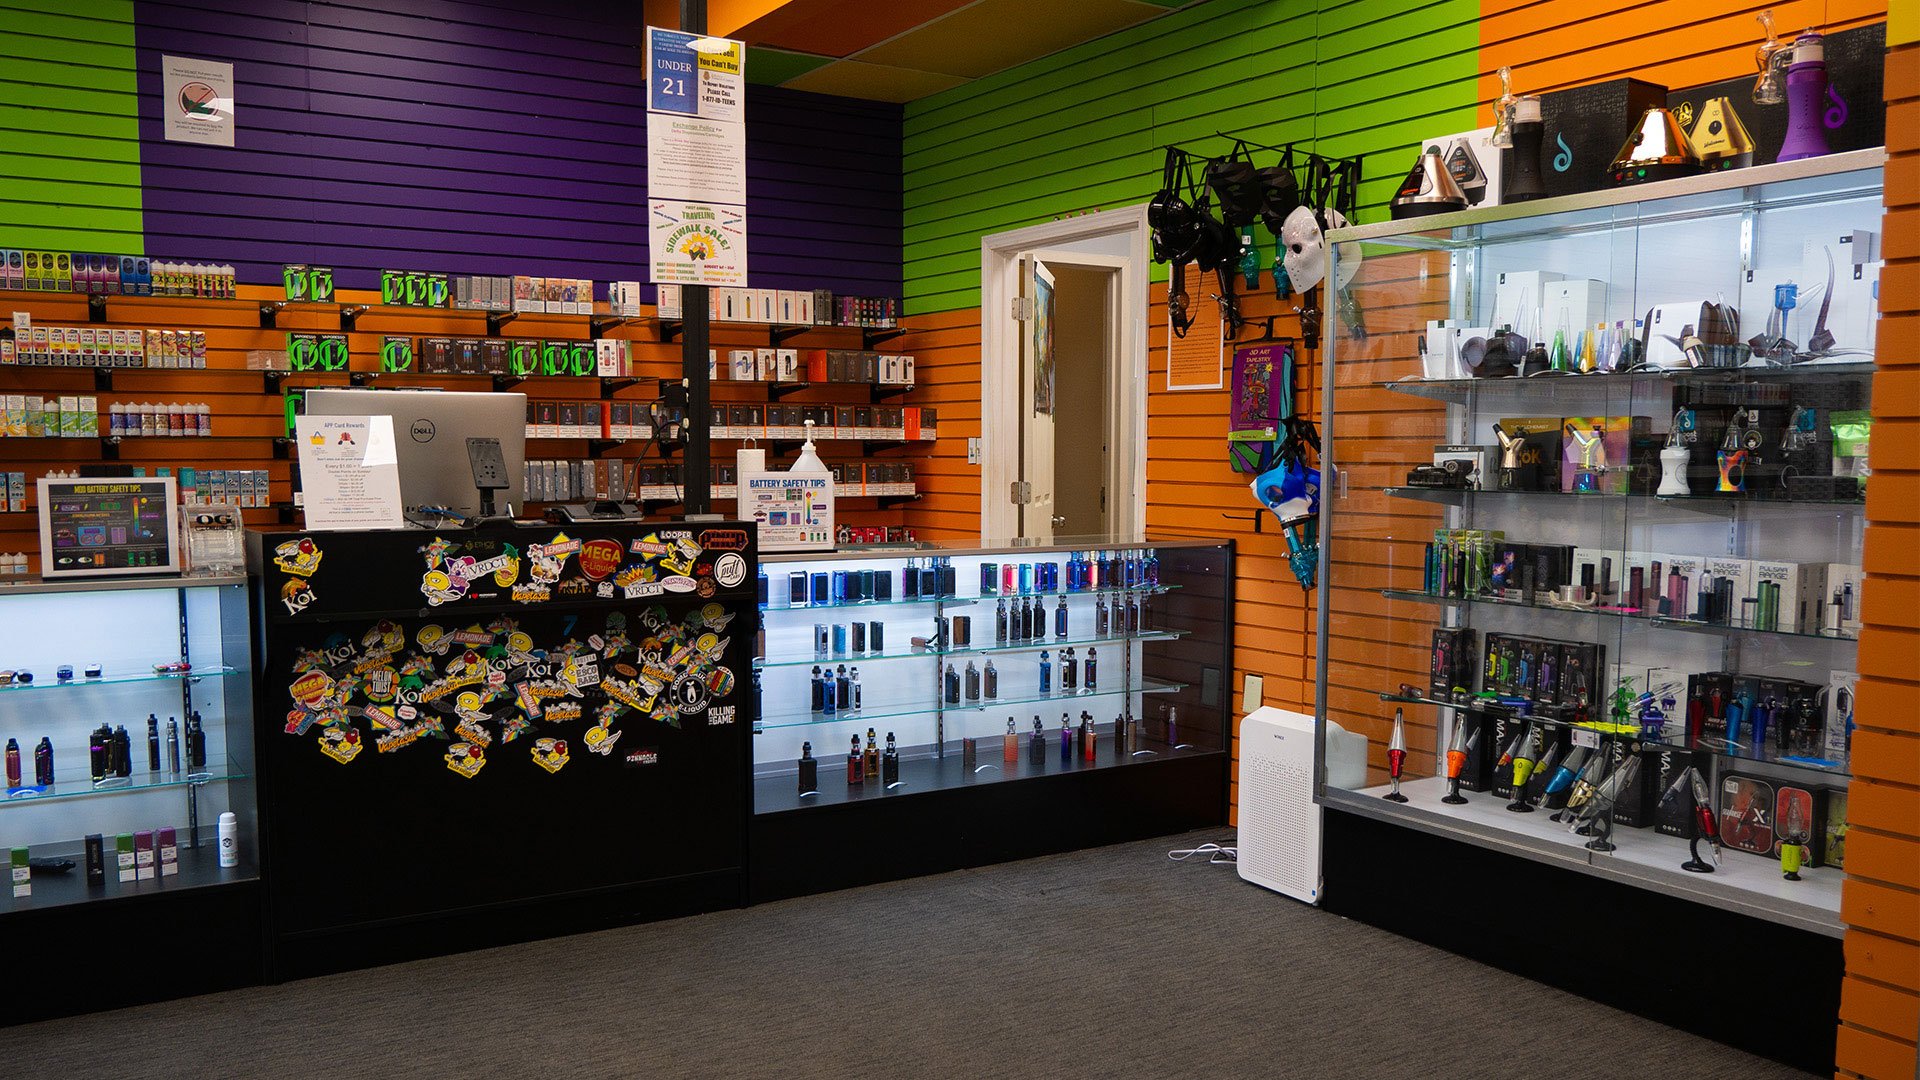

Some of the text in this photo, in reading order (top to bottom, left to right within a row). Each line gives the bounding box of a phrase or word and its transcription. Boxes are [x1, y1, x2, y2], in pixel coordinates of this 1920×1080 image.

[657, 59, 692, 73] UNDER
[699, 58, 738, 71] You Can't Buy
[662, 77, 686, 96] 21
[699, 124, 715, 132] Policy
[682, 211, 715, 220] TRAVELING
[665, 224, 701, 254] SIDEWALK
[704, 225, 731, 251] SALE!
[413, 427, 433, 435] DELL
[74, 484, 141, 493] MOD BATTERY SAFETY TIPS
[750, 479, 826, 488] BATTERY SAFETY TIPS
[196, 514, 232, 525] OG
[661, 530, 693, 539] LOOPER
[544, 543, 579, 555] LEMONADE
[580, 544, 622, 563] MEGA
[633, 541, 668, 554] LEMONADE
[470, 558, 507, 574] VRDCT
[583, 560, 617, 573] E-Liquids
[1670, 559, 1696, 567] PULSAR
[1713, 562, 1741, 570] PULSAR
[1759, 565, 1788, 573] PULSAR
[1713, 568, 1741, 577] RANGE
[1759, 571, 1788, 580] RANGE
[628, 584, 661, 596] VRDCT
[281, 585, 318, 616] Koi
[638, 606, 665, 634] Koi
[455, 633, 492, 643] LEMONADE
[324, 638, 358, 668] Koi
[637, 647, 663, 665] Koi
[486, 657, 513, 676] Koi
[526, 661, 552, 679] Koi
[576, 666, 597, 677] ESCO
[372, 670, 393, 681] MELON
[578, 675, 599, 686] BARS
[291, 677, 325, 696] MEGA
[393, 686, 423, 706] Koi
[708, 705, 736, 717] KILLING
[366, 706, 401, 729] LEMONADE
